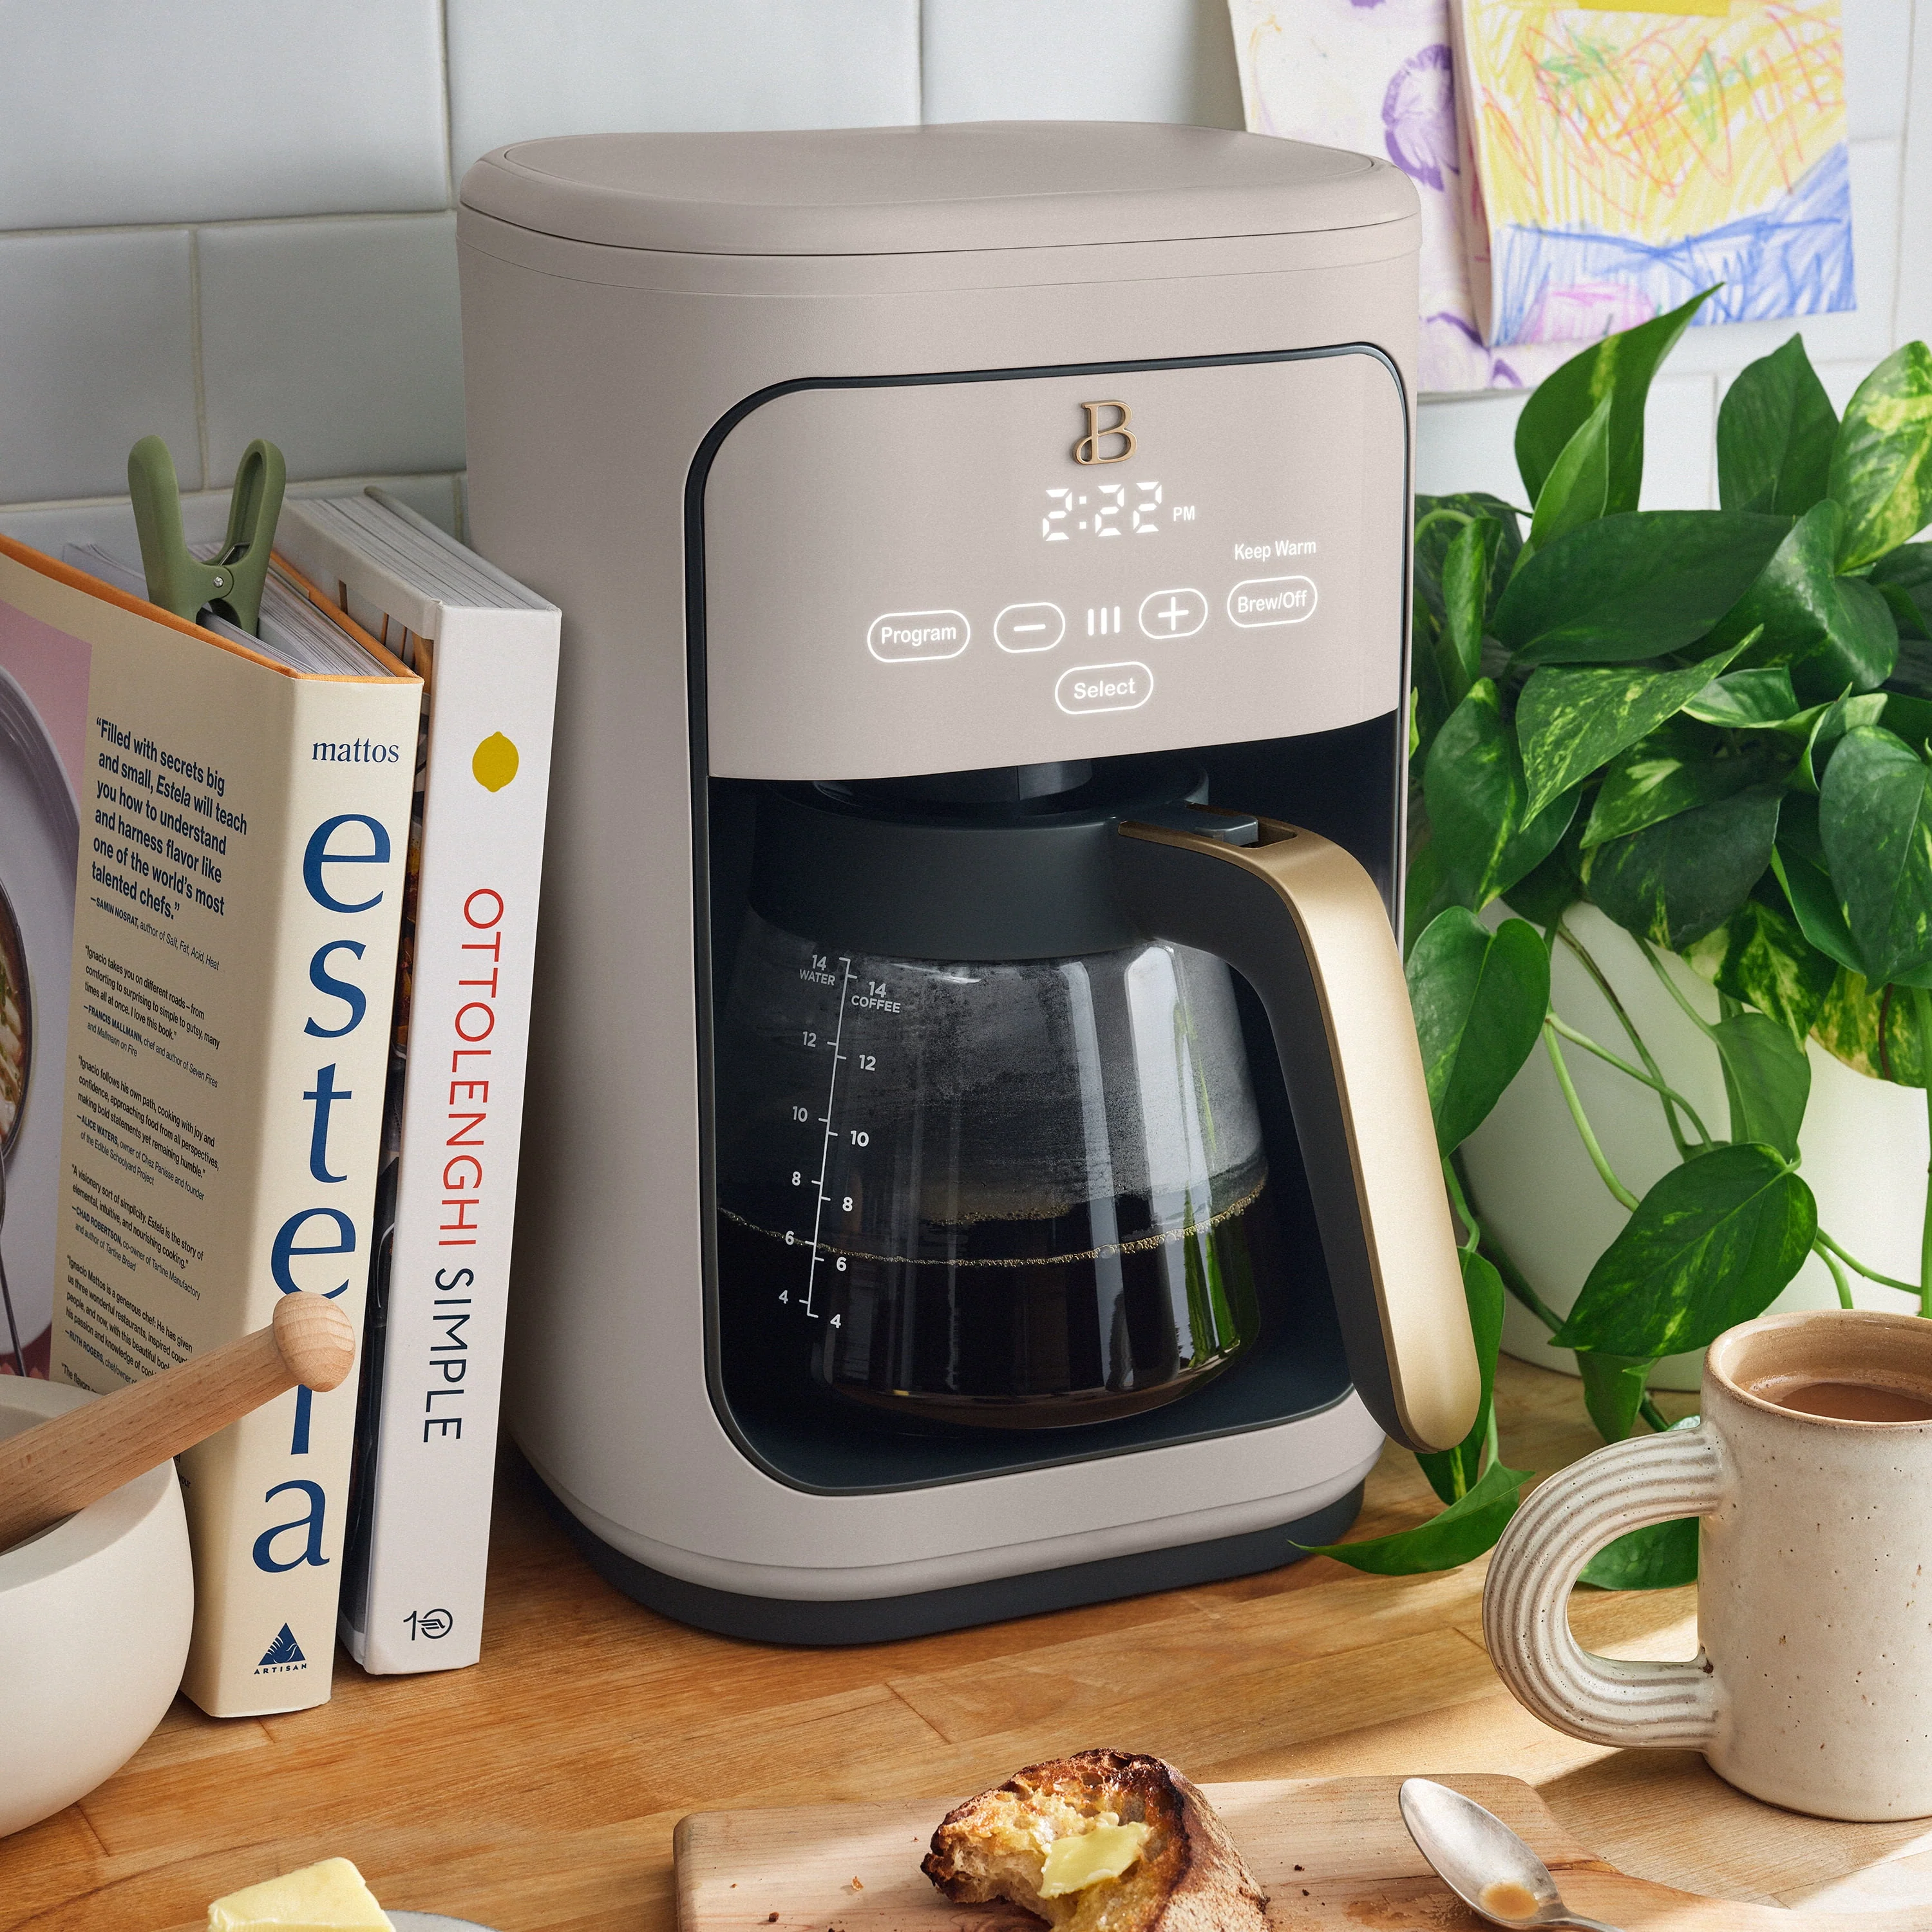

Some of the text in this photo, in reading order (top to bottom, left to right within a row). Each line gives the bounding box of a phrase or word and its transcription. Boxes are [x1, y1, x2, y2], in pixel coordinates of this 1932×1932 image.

[1043, 482, 1195, 541] 2:22 PM
[1235, 540, 1316, 562] Keep Warm
[1237, 589, 1308, 614] Brew/Off
[882, 627, 956, 646] Program
[1074, 678, 1135, 699] Select
[133, 737, 157, 762] with
[160, 751, 204, 783] secrets
[206, 766, 225, 797] big
[312, 738, 399, 762] mattos
[99, 752, 247, 835] and small, Estela will teach
[97, 780, 227, 855] you how to understand
[95, 809, 222, 883] and harness flavor like
[91, 860, 137, 900] talented
[93, 837, 224, 916] one of the world’s most
[140, 922, 158, 937] author
[159, 931, 166, 941] of
[205, 954, 219, 971] Heat
[813, 954, 826, 971] 14
[108, 957, 123, 974] takes
[124, 968, 135, 981] you
[135, 975, 143, 985] on
[144, 978, 168, 999] different
[799, 969, 836, 986] WATER
[869, 981, 886, 998] 14
[85, 981, 99, 998] times
[108, 996, 113, 1006] at
[131, 1006, 133, 1017] I
[134, 1008, 146, 1023] love
[147, 1016, 157, 1030] this
[86, 965, 115, 990] comforting
[117, 980, 122, 992] to
[123, 987, 151, 1010] surprising
[153, 1000, 158, 1012] to
[159, 1006, 178, 1023] simple
[179, 1016, 185, 1028] to
[204, 1032, 220, 1050] many
[851, 994, 902, 1014] COFFEE
[803, 1032, 816, 1047] 12
[144, 1037, 155, 1050] chef
[155, 1045, 165, 1056] and
[166, 1051, 182, 1066] author
[183, 1061, 189, 1070] of
[189, 1063, 204, 1079] Seven
[205, 1073, 218, 1088] Fires
[859, 1055, 876, 1071] 12
[100, 1068, 120, 1088] follows
[120, 1080, 129, 1094] his
[129, 1089, 142, 1103] own
[157, 1106, 180, 1128] cooking
[181, 1119, 193, 1133] with
[193, 1125, 203, 1141] joy
[204, 1134, 214, 1148] and
[110, 1095, 144, 1124] approaching
[146, 1114, 158, 1131] food
[160, 1123, 173, 1140] from
[793, 1106, 808, 1122] 10
[78, 1092, 97, 1113] making
[97, 1103, 109, 1119] bold
[110, 1113, 141, 1139] statements
[142, 1133, 151, 1145] yet
[152, 1139, 179, 1165] remaining
[851, 1130, 869, 1146] 10
[120, 1141, 135, 1155] owner
[135, 1151, 141, 1159] of
[142, 1153, 154, 1168] Chez
[155, 1161, 174, 1181] Panisse
[175, 1176, 184, 1188] and
[185, 1180, 204, 1200] founder
[424, 889, 504, 1443] OTTOLENGHI SIMPLE
[792, 1171, 800, 1186] 8
[78, 1170, 101, 1193] visionary
[102, 1186, 113, 1200] sort
[113, 1195, 120, 1204] of
[147, 1215, 164, 1235] Estela
[165, 1227, 170, 1239] is
[171, 1231, 180, 1245] the
[181, 1240, 196, 1258] story
[197, 1251, 204, 1261] of
[842, 1197, 853, 1211] 8
[122, 1218, 133, 1231] and
[133, 1226, 161, 1253] nourishing
[786, 1231, 794, 1245] 6
[837, 1257, 846, 1271] 6
[88, 1269, 106, 1291] Mattos
[106, 1283, 111, 1295] is
[111, 1290, 115, 1298] a
[116, 1293, 141, 1316] generous
[142, 1311, 156, 1327] chef:
[156, 1319, 165, 1333] He
[166, 1325, 176, 1341] has
[176, 1336, 192, 1353] given
[779, 1290, 788, 1303] 4
[68, 1274, 73, 1285] us
[75, 1278, 88, 1296] three
[89, 1290, 115, 1316] wonderful
[148, 1331, 170, 1356] inspired
[830, 1314, 841, 1328] 4
[254, 1663, 308, 1675] ARTISAN
